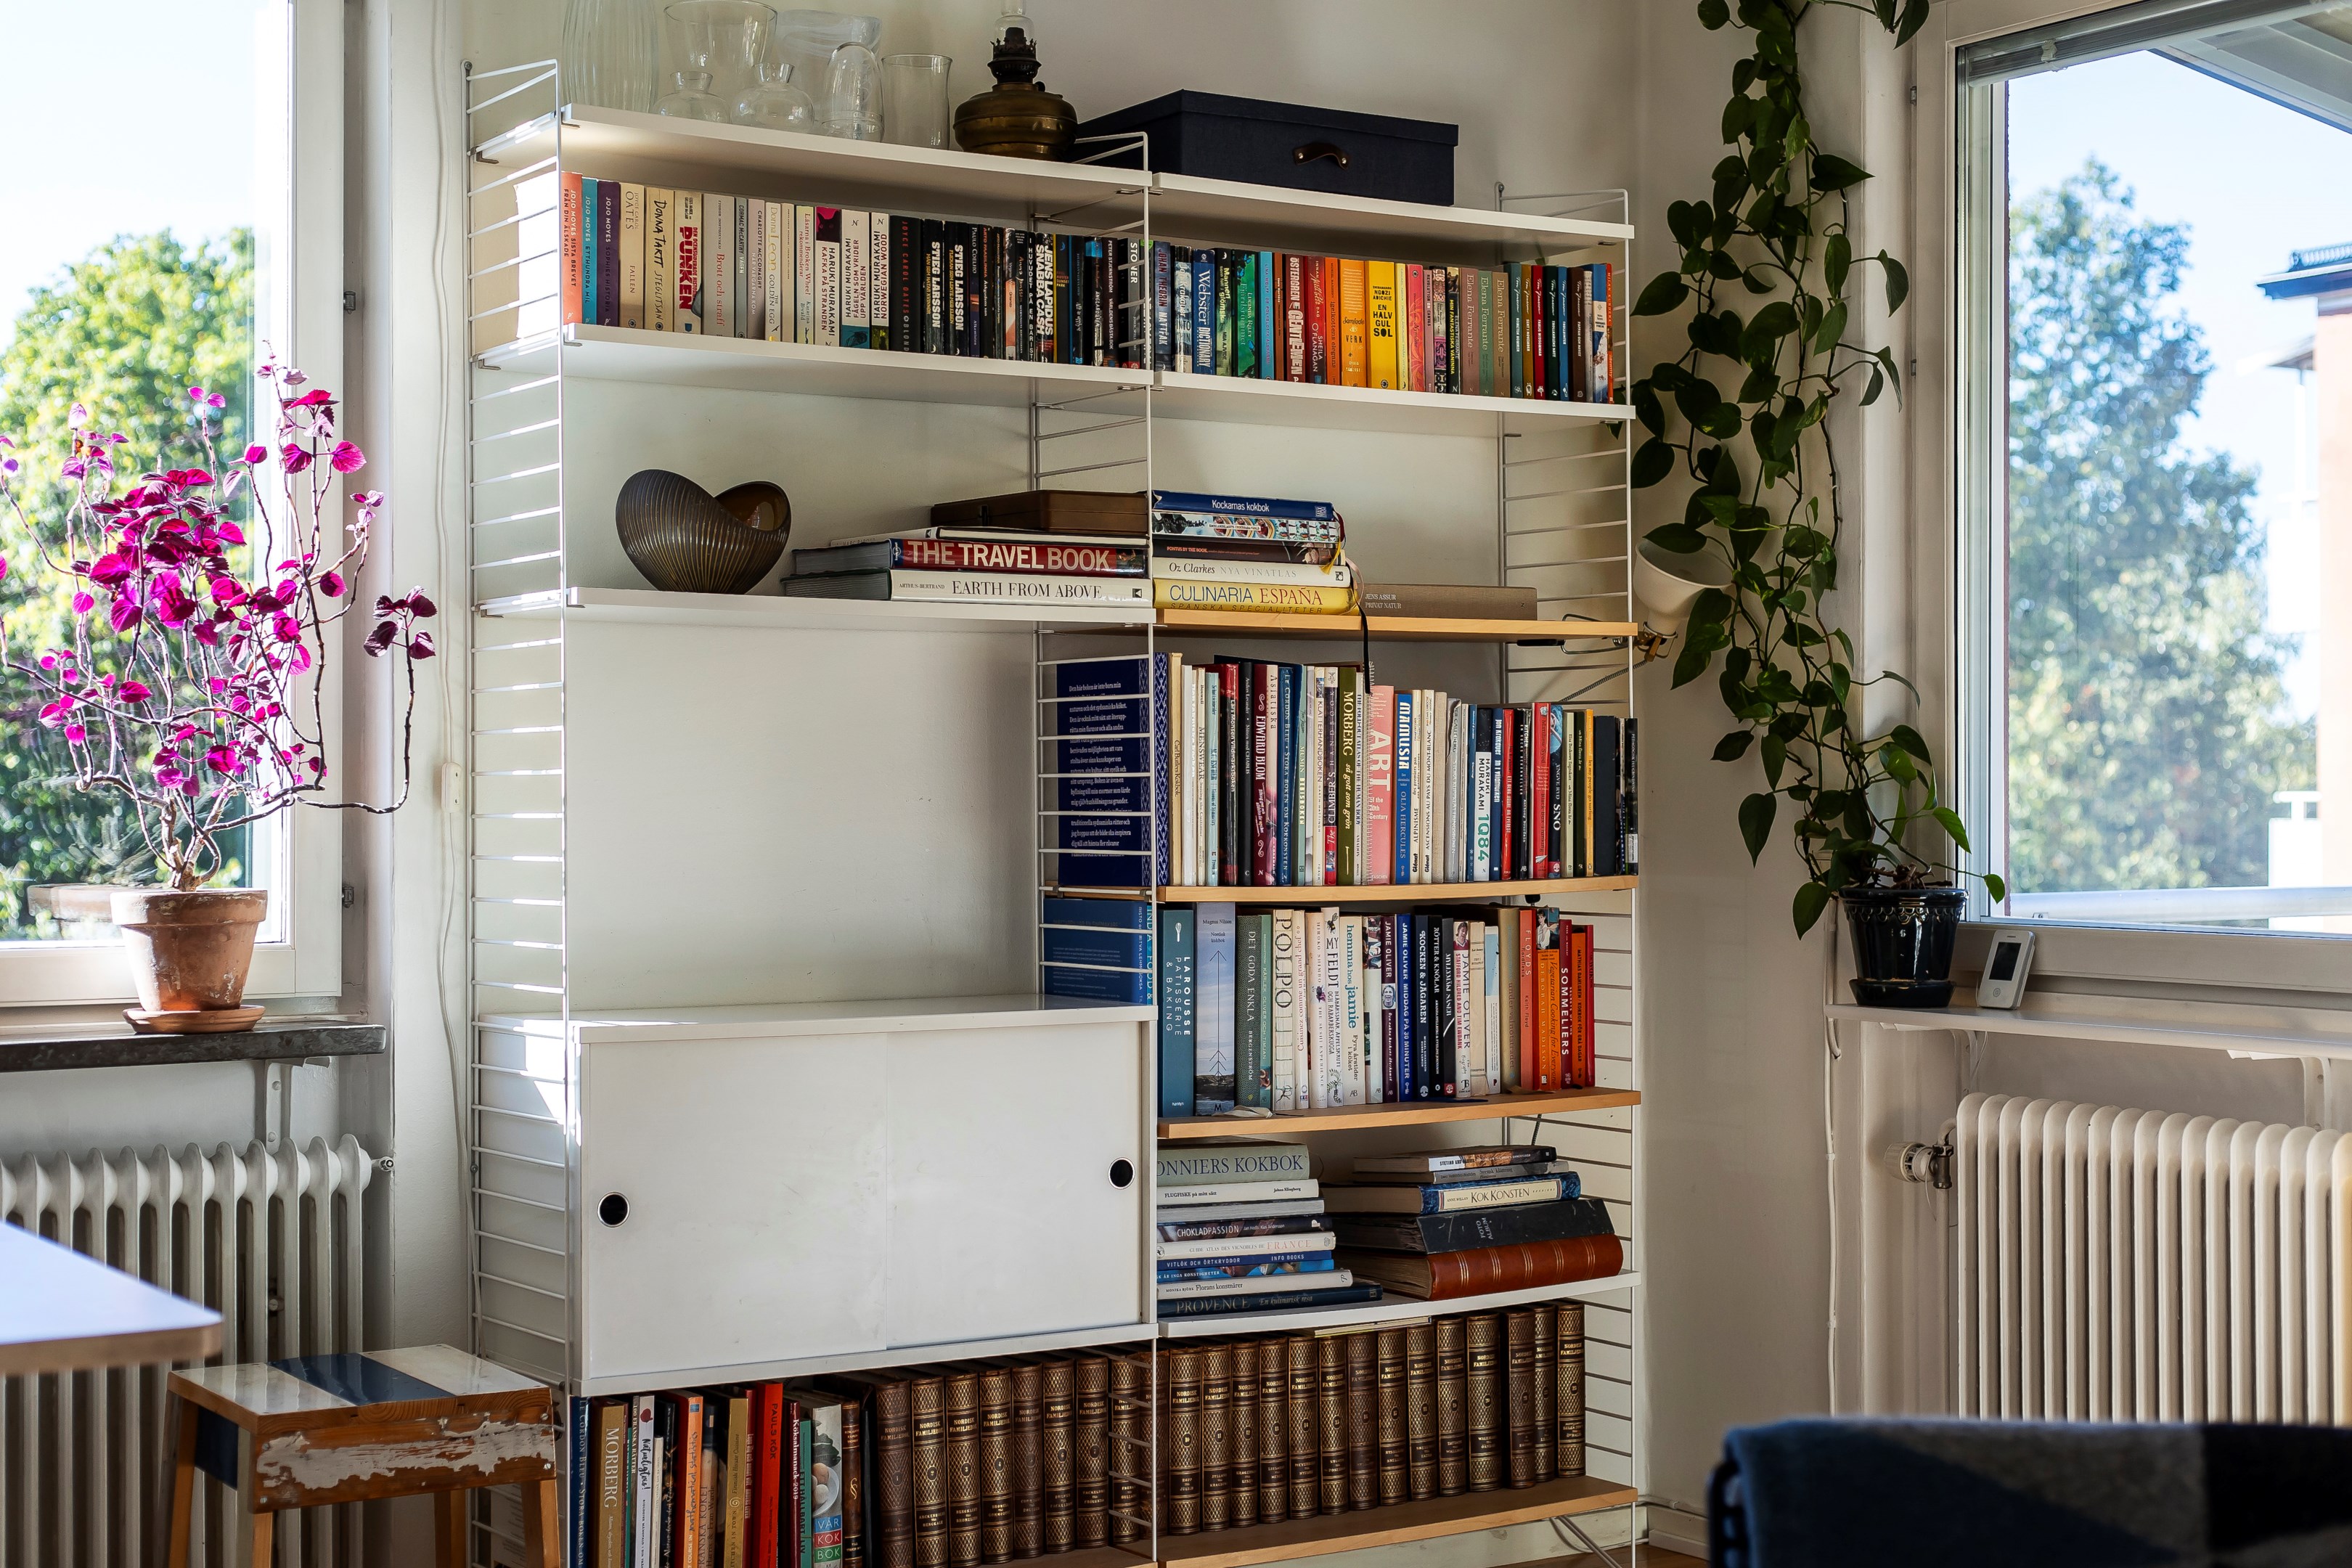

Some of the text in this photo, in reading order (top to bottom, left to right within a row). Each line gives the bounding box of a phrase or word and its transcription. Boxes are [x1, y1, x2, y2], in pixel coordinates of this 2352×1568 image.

[626, 192, 634, 230] OATES
[654, 200, 667, 320] DONNA TARTT STEGLITSAN
[679, 226, 693, 309] PUNKEN
[768, 234, 779, 271] Leon
[1045, 245, 1053, 279] JENS
[822, 276, 829, 285] PÅ
[931, 242, 940, 328] STIEG LARSSON
[1036, 245, 1045, 298] SNABBA
[1029, 293, 1033, 304] PÅ
[1199, 269, 1211, 325] Webster
[1029, 309, 1033, 319] EN
[1289, 257, 1304, 375] ÖSTERGREN GENTLEMEN
[1199, 327, 1210, 367] DICTIONARY
[1373, 328, 1392, 338] SOL
[1212, 499, 1269, 512] Kockarnas kokbok
[907, 540, 1109, 571] THE TRAVEL BOOK
[1169, 563, 1181, 573] Oz
[1183, 563, 1214, 574] Clarkes
[1244, 568, 1297, 578] VINATLAS
[952, 580, 1003, 595] EARTH
[1008, 582, 1050, 597] FROM
[1054, 584, 1103, 599] ABOVE
[1169, 584, 1323, 605] CULINARIA ESPAÑA
[1170, 603, 1322, 614] SPANSKA SPECIALITETER
[1344, 692, 1354, 756] MORBERG
[1399, 703, 1411, 769] MAMUSIA
[1255, 716, 1267, 781] EDWARD BLOM
[1370, 730, 1392, 792] ART
[1478, 814, 1490, 862] 1Q84
[1248, 931, 1257, 950] DET
[1346, 924, 1355, 968] hemma
[1247, 955, 1257, 984] GODA
[1275, 916, 1292, 1008] POLPO
[1327, 952, 1339, 988] FELDT
[1246, 987, 1255, 1021] ENKLA
[1345, 984, 1359, 1028] jamie
[1419, 981, 1428, 1024] JÄGAREN
[1403, 1018, 1410, 1029] PÅ
[1403, 1031, 1409, 1040] 30
[1157, 1155, 1304, 1177] ONNIERS KOKBOK
[1177, 1225, 1240, 1238] CHOKLADPASSION
[1476, 1220, 1486, 1238] FOTO
[1481, 1218, 1494, 1240] ALBUM
[1176, 1297, 1251, 1314] PROVENCE
[919, 1421, 941, 1429] NORDISK
[604, 1427, 620, 1508] MORBERG
[639, 1438, 651, 1490] Naturligtvis!
[817, 1518, 840, 1530] VÅR
[817, 1532, 840, 1545] KOK
[817, 1548, 841, 1560] BOK
